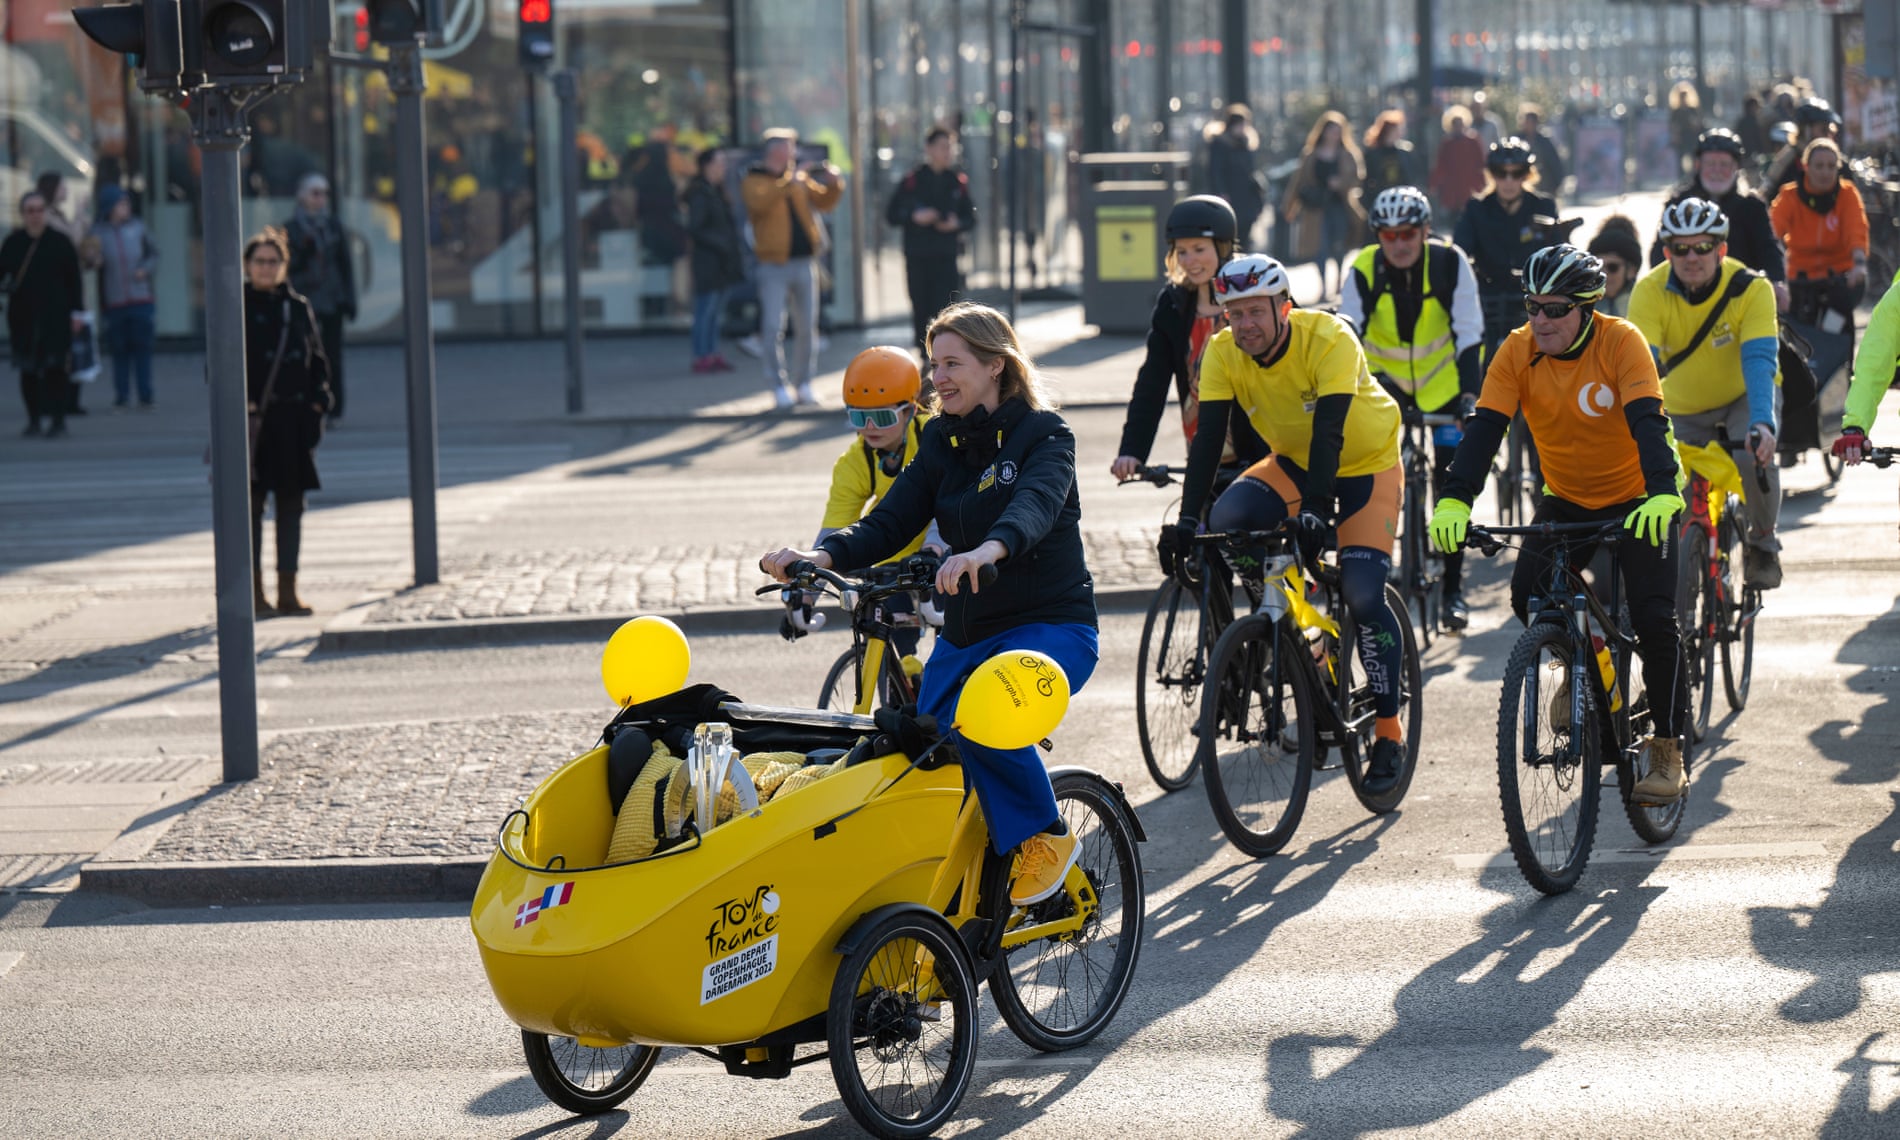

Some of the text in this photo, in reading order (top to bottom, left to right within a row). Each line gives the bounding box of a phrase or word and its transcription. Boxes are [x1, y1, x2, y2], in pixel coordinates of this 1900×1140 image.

[1358, 623, 1384, 694] AMAGER
[752, 912, 763, 922] de
[709, 940, 772, 977] GRAND DEPART
[712, 953, 768, 986] COPENHAGUE
[705, 961, 773, 1000] DANEMARK 2022
